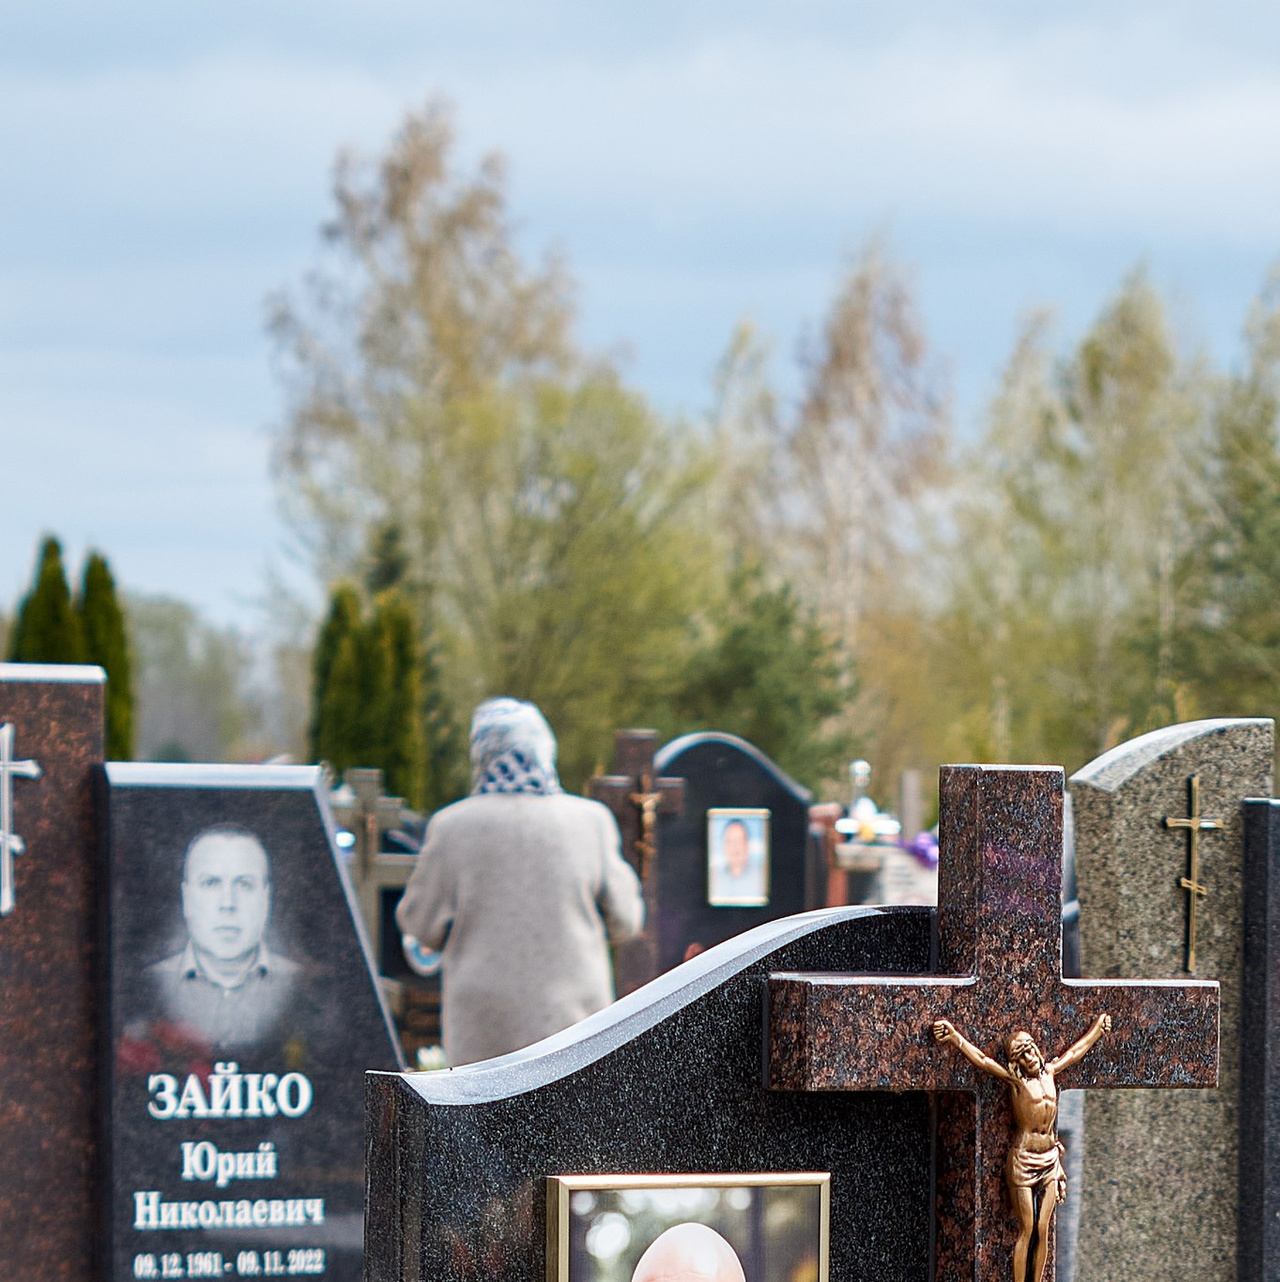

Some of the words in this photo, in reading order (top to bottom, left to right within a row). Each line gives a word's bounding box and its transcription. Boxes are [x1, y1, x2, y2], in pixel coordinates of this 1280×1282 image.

[148, 1062, 313, 1119] ЗАЙКО
[180, 1141, 278, 1187] Юрий
[133, 1191, 325, 1230] Николаевич
